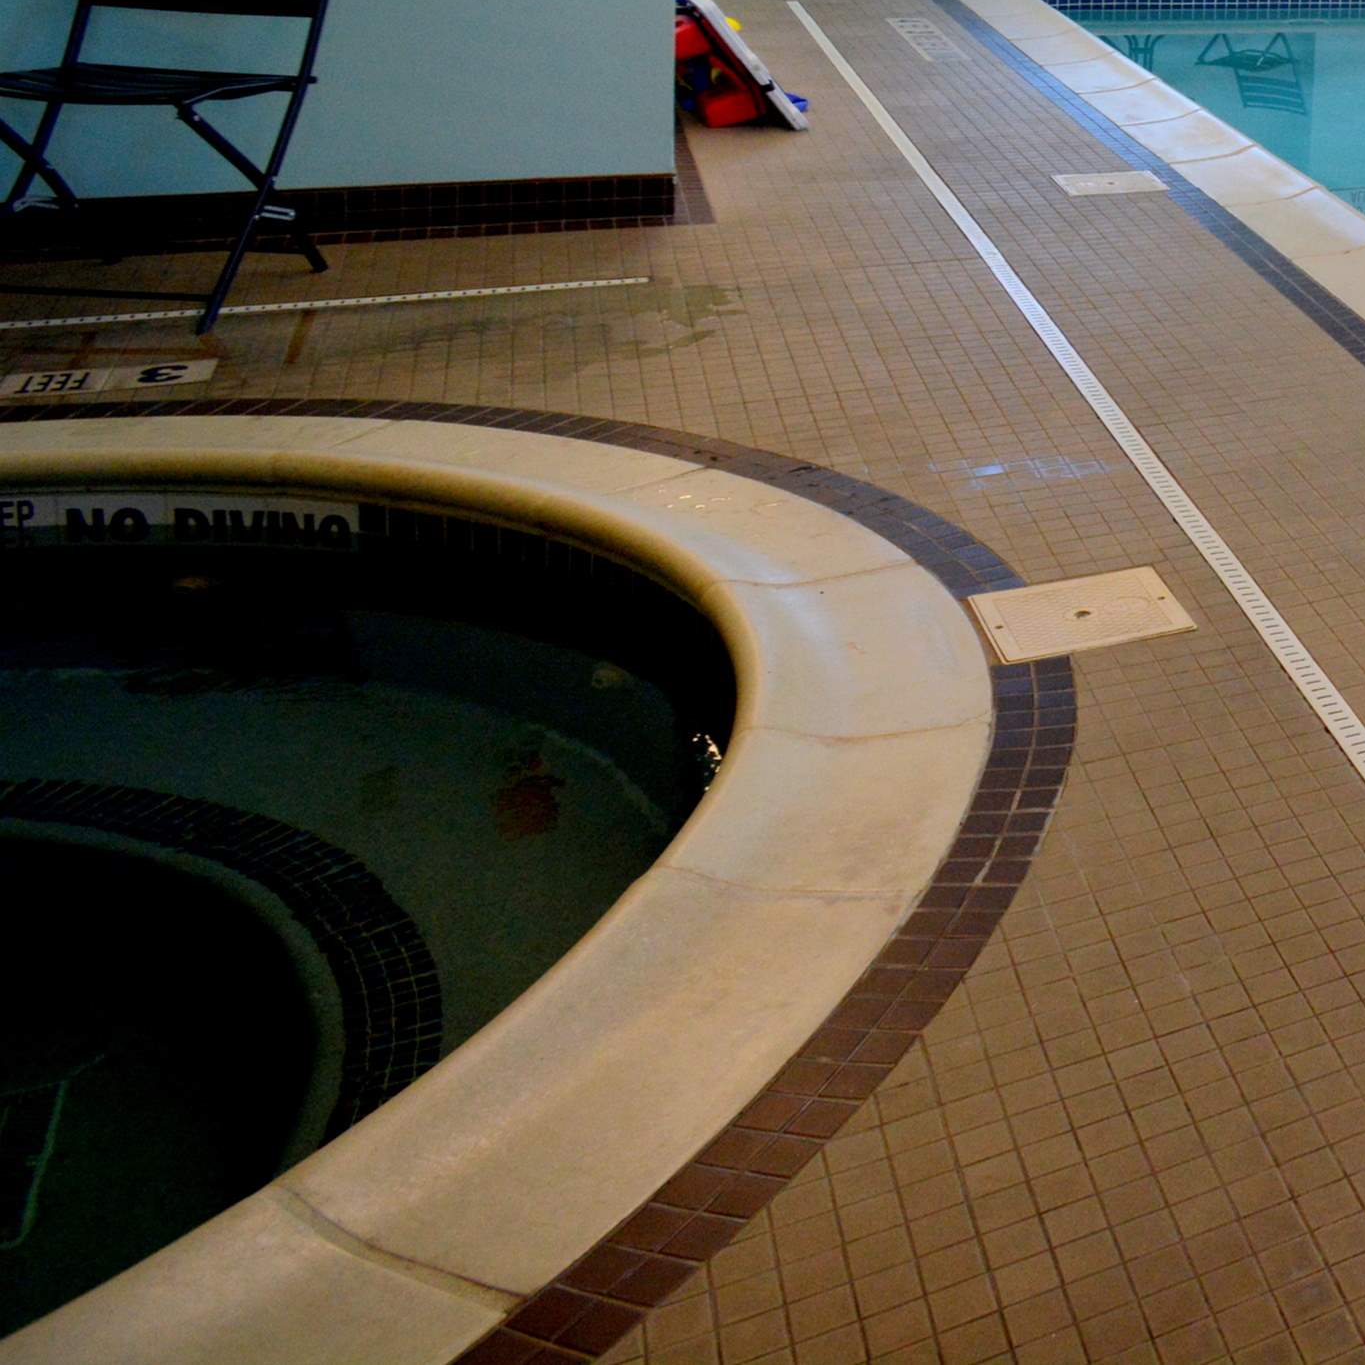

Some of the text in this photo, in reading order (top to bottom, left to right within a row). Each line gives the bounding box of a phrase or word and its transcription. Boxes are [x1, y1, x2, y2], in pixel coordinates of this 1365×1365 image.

[15, 364, 188, 394] 3 FEET
[65, 507, 149, 542] NO
